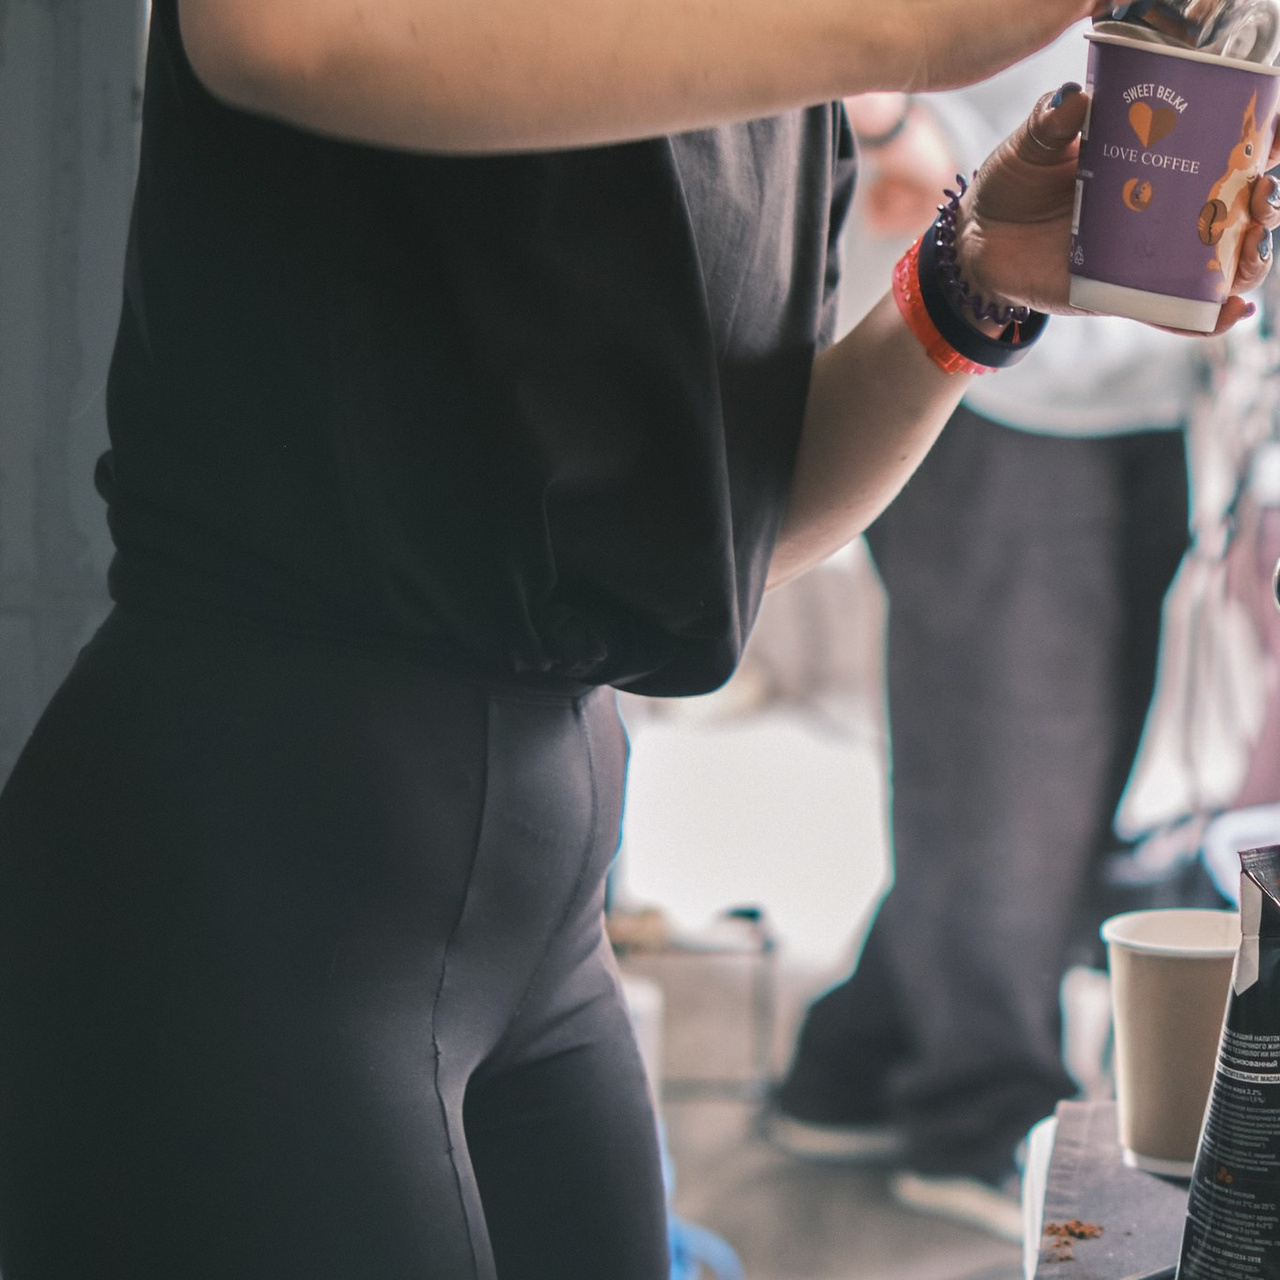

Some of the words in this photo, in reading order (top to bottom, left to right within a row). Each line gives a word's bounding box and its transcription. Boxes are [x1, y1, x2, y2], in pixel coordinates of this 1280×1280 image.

[1123, 84, 1154, 104] SWEET
[1157, 85, 1188, 114] BELKA
[1103, 143, 1138, 163] LOVE
[1141, 152, 1201, 175] COFFEE
